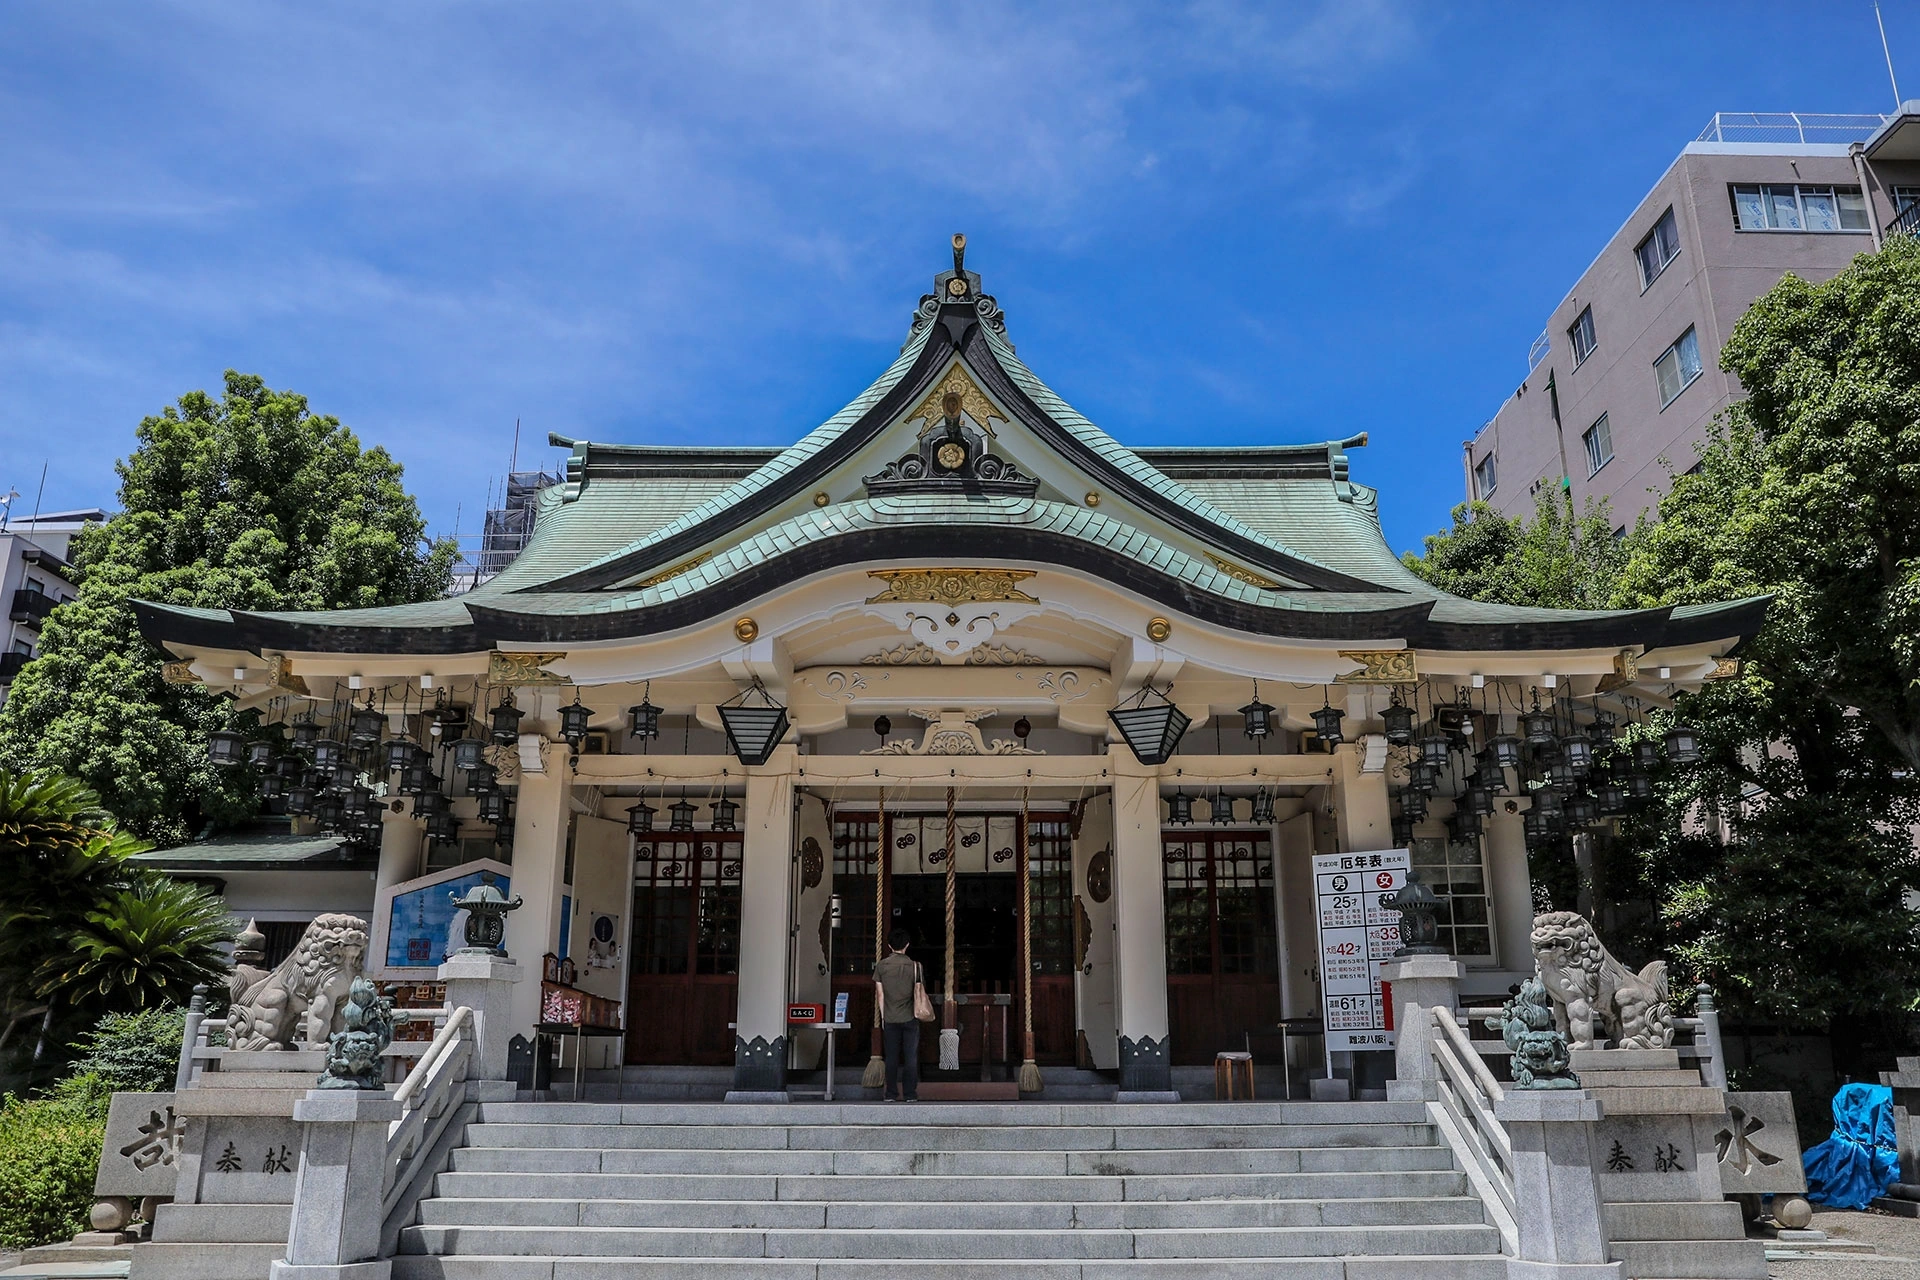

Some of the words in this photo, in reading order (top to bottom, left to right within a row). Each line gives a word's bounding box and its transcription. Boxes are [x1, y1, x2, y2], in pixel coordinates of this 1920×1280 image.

[1340, 854, 1382, 870] 厄年表
[1333, 877, 1347, 890] 男
[1378, 874, 1391, 887] 女
[1349, 1035, 1387, 1044] 難波八阪
[1714, 1105, 1784, 1176] 水
[215, 1141, 293, 1175] 奉献
[1607, 1140, 1685, 1173] 奉献
